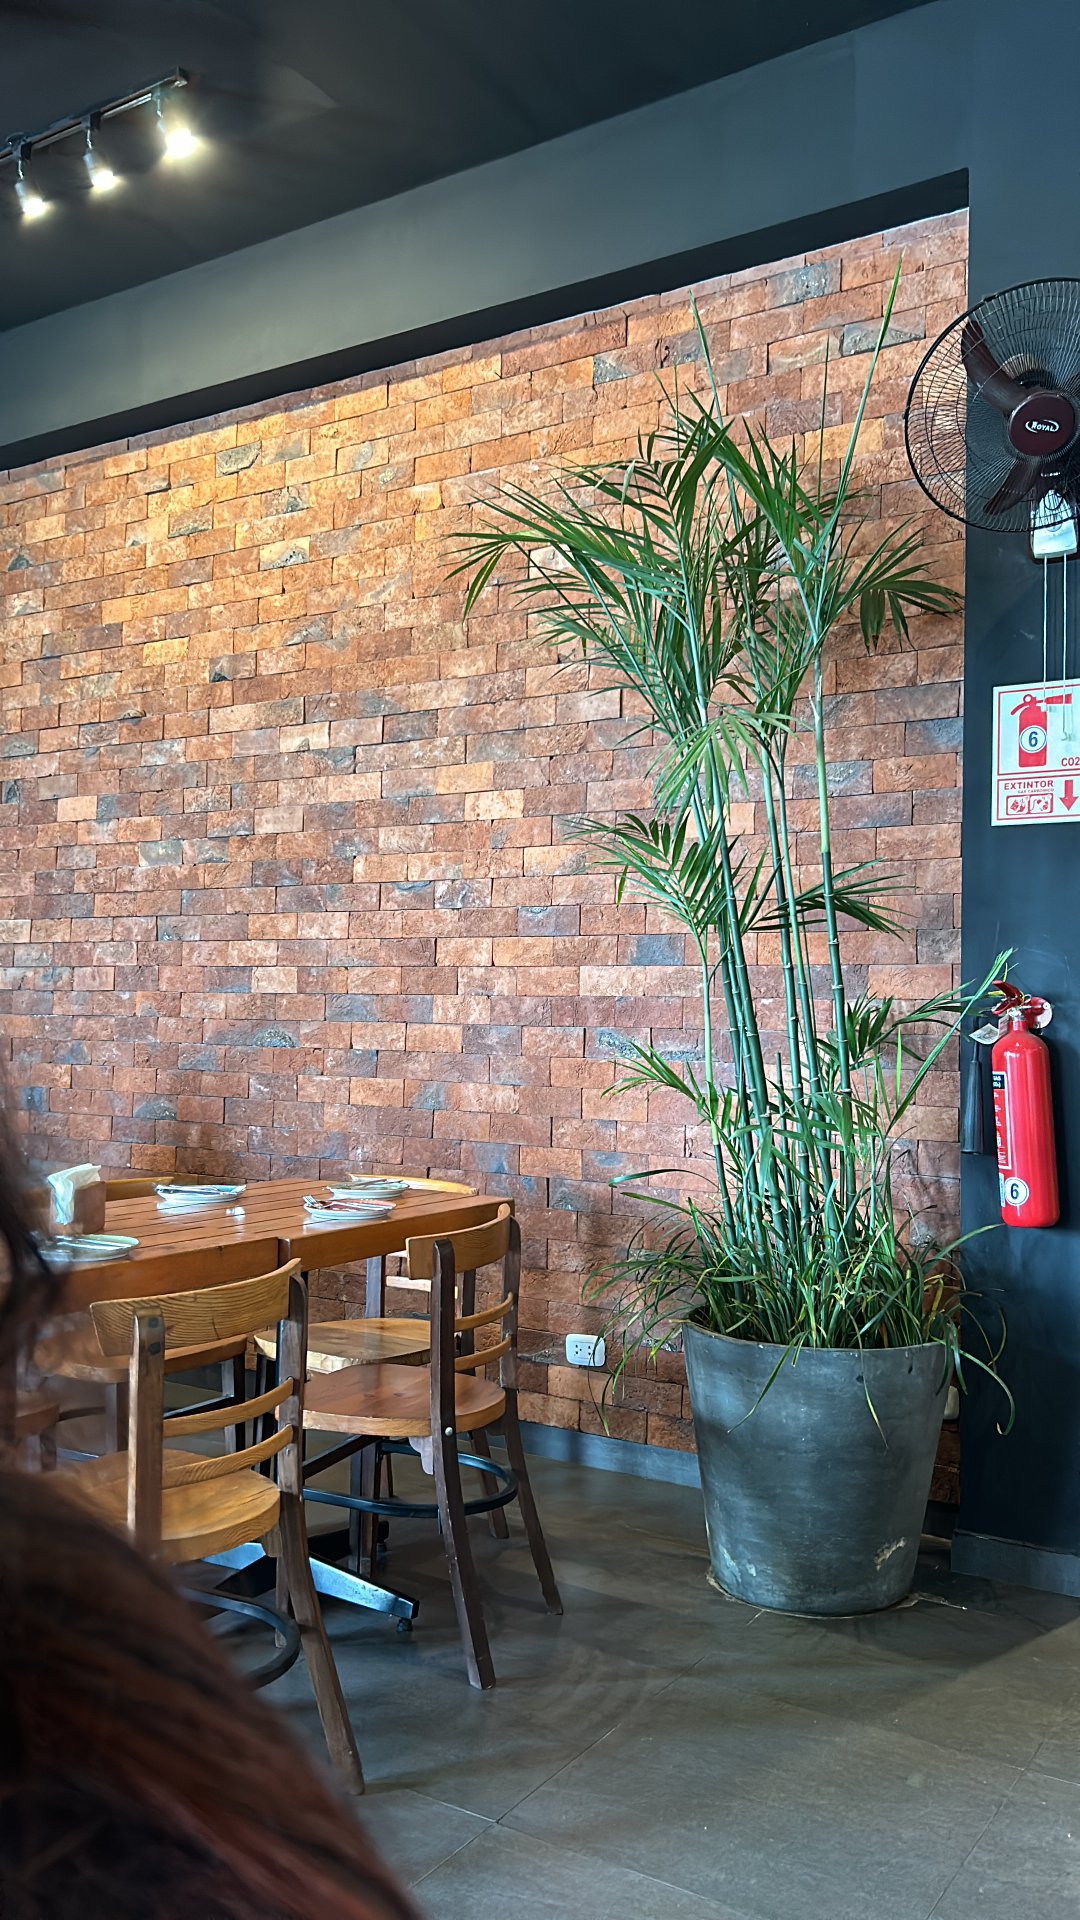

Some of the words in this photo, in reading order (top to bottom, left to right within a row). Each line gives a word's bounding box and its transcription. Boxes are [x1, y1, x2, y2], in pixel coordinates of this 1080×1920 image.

[1028, 731, 1039, 747] 6
[1004, 780, 1053, 790] EXTINTOR
[1010, 1183, 1019, 1200] 6
